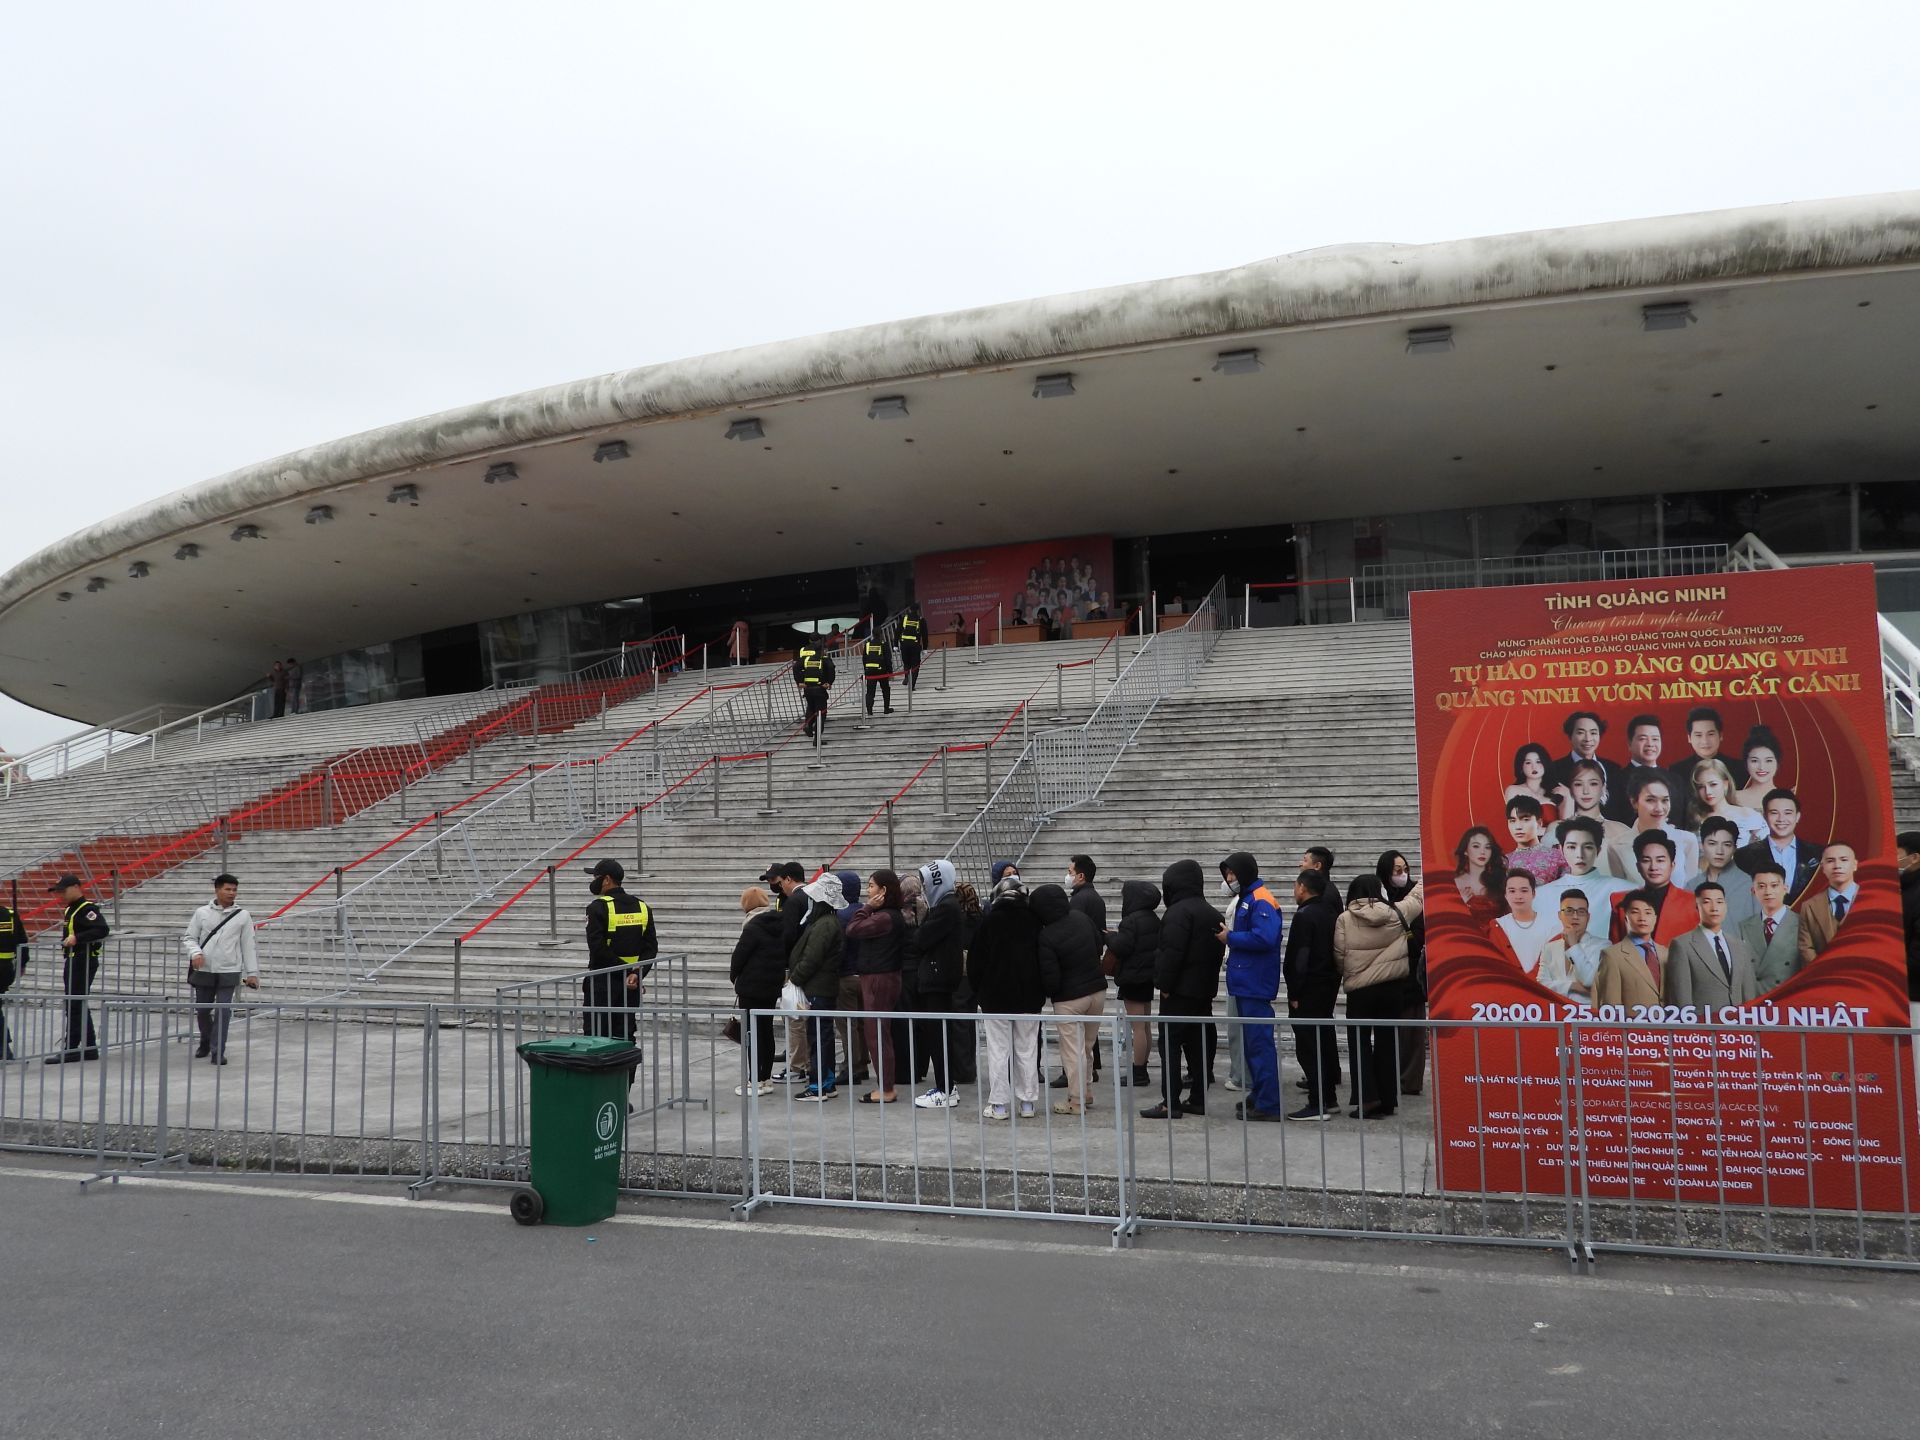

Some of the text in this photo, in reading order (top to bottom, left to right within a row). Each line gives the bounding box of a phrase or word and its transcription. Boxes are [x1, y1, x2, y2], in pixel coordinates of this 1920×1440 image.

[1597, 588, 1669, 609] QUẢNG
[1675, 587, 1726, 603] NINH
[1551, 609, 1724, 633] Chương trình nghệ thuật
[1528, 637, 1560, 646] THÀNH
[1562, 635, 1589, 644] CÔNG
[1611, 632, 1628, 642] HỘI
[1661, 629, 1687, 639] TOÀN
[1690, 627, 1719, 638] QUỐC
[1744, 624, 1765, 634] THỨ
[1766, 625, 1783, 633] XIV
[1539, 646, 1571, 656] THÀNH
[1624, 642, 1659, 653] QUANG
[1661, 641, 1685, 650] VINH
[1688, 640, 1701, 649] VÀ
[1703, 638, 1726, 648] ĐÓN
[1728, 636, 1756, 646] XUÂN
[1781, 635, 1804, 644] 2026
[1450, 647, 1848, 685] TỰ HÀO THEO ĐẢNG QUANG VINH
[1435, 671, 1862, 710] QUẢNG NINH VƯƠN MÌNH CẤT CÁNH
[1471, 1003, 1543, 1022] 20:00
[1562, 1004, 1697, 1024] 25.01.2026
[1719, 1000, 1779, 1025] CHỦ
[1628, 1031, 1669, 1045] Quảng
[1719, 1034, 1757, 1046] 30-10,
[1555, 1045, 1603, 1057] pờng
[1606, 1046, 1623, 1058] Hạ
[1626, 1046, 1661, 1058] Long,
[1664, 1047, 1689, 1057] tnh
[1487, 1075, 1505, 1084] HÁT
[1535, 1077, 1561, 1087] THUẬ
[1567, 1076, 1589, 1086] TỈH
[1592, 1078, 1626, 1088] QUẢNG
[1628, 1080, 1653, 1088] NINH
[1673, 1069, 1705, 1079] Truyền
[1707, 1069, 1728, 1078] hnh
[1731, 1070, 1750, 1079] trực
[1753, 1070, 1772, 1080] tếp
[1774, 1071, 1794, 1079] trên
[1673, 1080, 1692, 1089] Báo
[1693, 1081, 1705, 1089] và
[1762, 1082, 1796, 1092] Truyền
[1798, 1083, 1820, 1092] hnh
[1823, 1083, 1852, 1093] Quản
[1858, 1085, 1883, 1094] Ninh
[1658, 1102, 1682, 1110] NGỆ
[1630, 1116, 1655, 1124] HOÀN
[1450, 1140, 1476, 1148] MONO
[1493, 1141, 1509, 1149] HUY
[1728, 1134, 1752, 1142] PHÚC
[1771, 1136, 1790, 1144] ANH
[1856, 1138, 1880, 1147] ÙNG
[1538, 1158, 1554, 1166] CLB
[1685, 1164, 1707, 1172] NINH
[1780, 1168, 1805, 1176] LONG
[1588, 1174, 1600, 1182] VŨ
[1603, 1175, 1628, 1183] ĐOÀN
